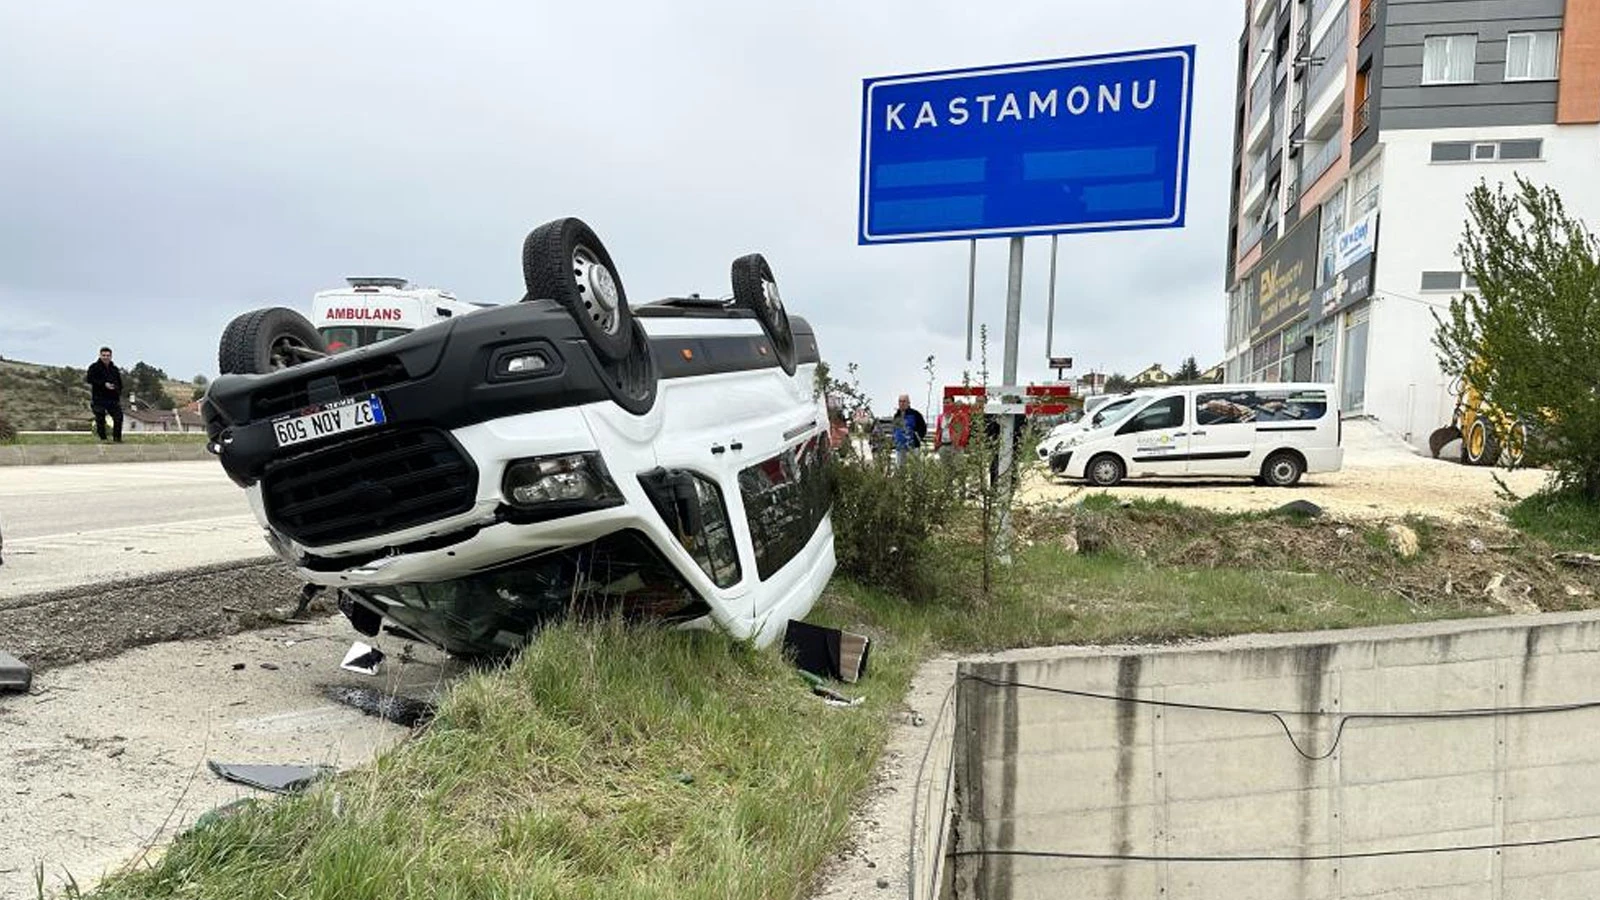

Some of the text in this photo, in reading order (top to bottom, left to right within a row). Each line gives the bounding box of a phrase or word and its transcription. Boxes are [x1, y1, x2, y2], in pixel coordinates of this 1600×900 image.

[886, 80, 1157, 131] KASTAMONU
[326, 308, 402, 321] AMBULANS
[354, 403, 374, 426] 37
[277, 420, 307, 443] 509
